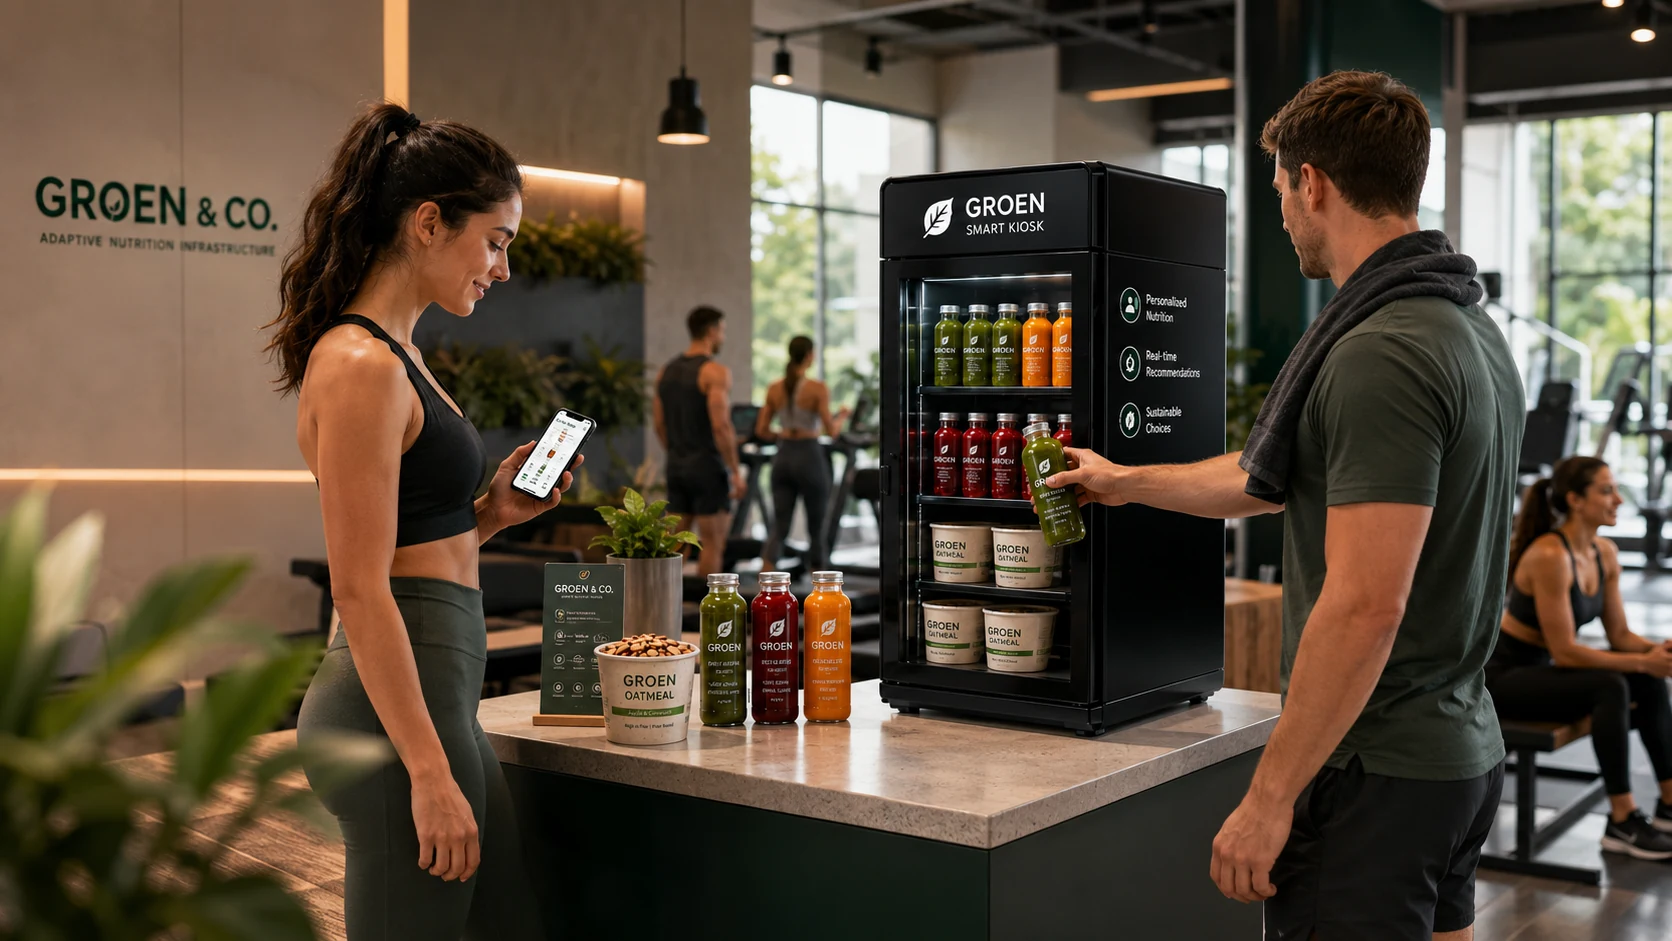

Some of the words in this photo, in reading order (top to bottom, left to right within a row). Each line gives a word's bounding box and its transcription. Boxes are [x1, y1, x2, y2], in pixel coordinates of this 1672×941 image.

[35, 176, 187, 226] GROEN
[197, 197, 217, 227] &
[225, 196, 278, 231] CO.
[965, 192, 1045, 218] GROEN
[966, 222, 1004, 236] SMART
[1008, 220, 1044, 233] KIOSK
[40, 233, 102, 247] ADAPTIVE
[109, 237, 174, 251] NUTRITION
[180, 241, 276, 257] INFRASTRUCTURE
[1146, 293, 1187, 308] Personalized
[1146, 311, 1174, 323] Nutrition
[1146, 366, 1200, 378] Recommendations
[1146, 406, 1182, 417] Sustainable
[1146, 422, 1171, 434] Choices
[935, 540, 966, 550] GROEN
[996, 543, 1029, 554] GROEN
[554, 584, 589, 593] GROEN
[598, 585, 614, 594] CO.
[927, 620, 960, 631] GROEN
[988, 626, 1021, 638] GROEN
[708, 643, 741, 652] GROEN
[759, 641, 793, 651] GROEN
[811, 640, 844, 650] GROEN
[623, 674, 676, 688] GROEN
[625, 690, 674, 701] OATMEAL
